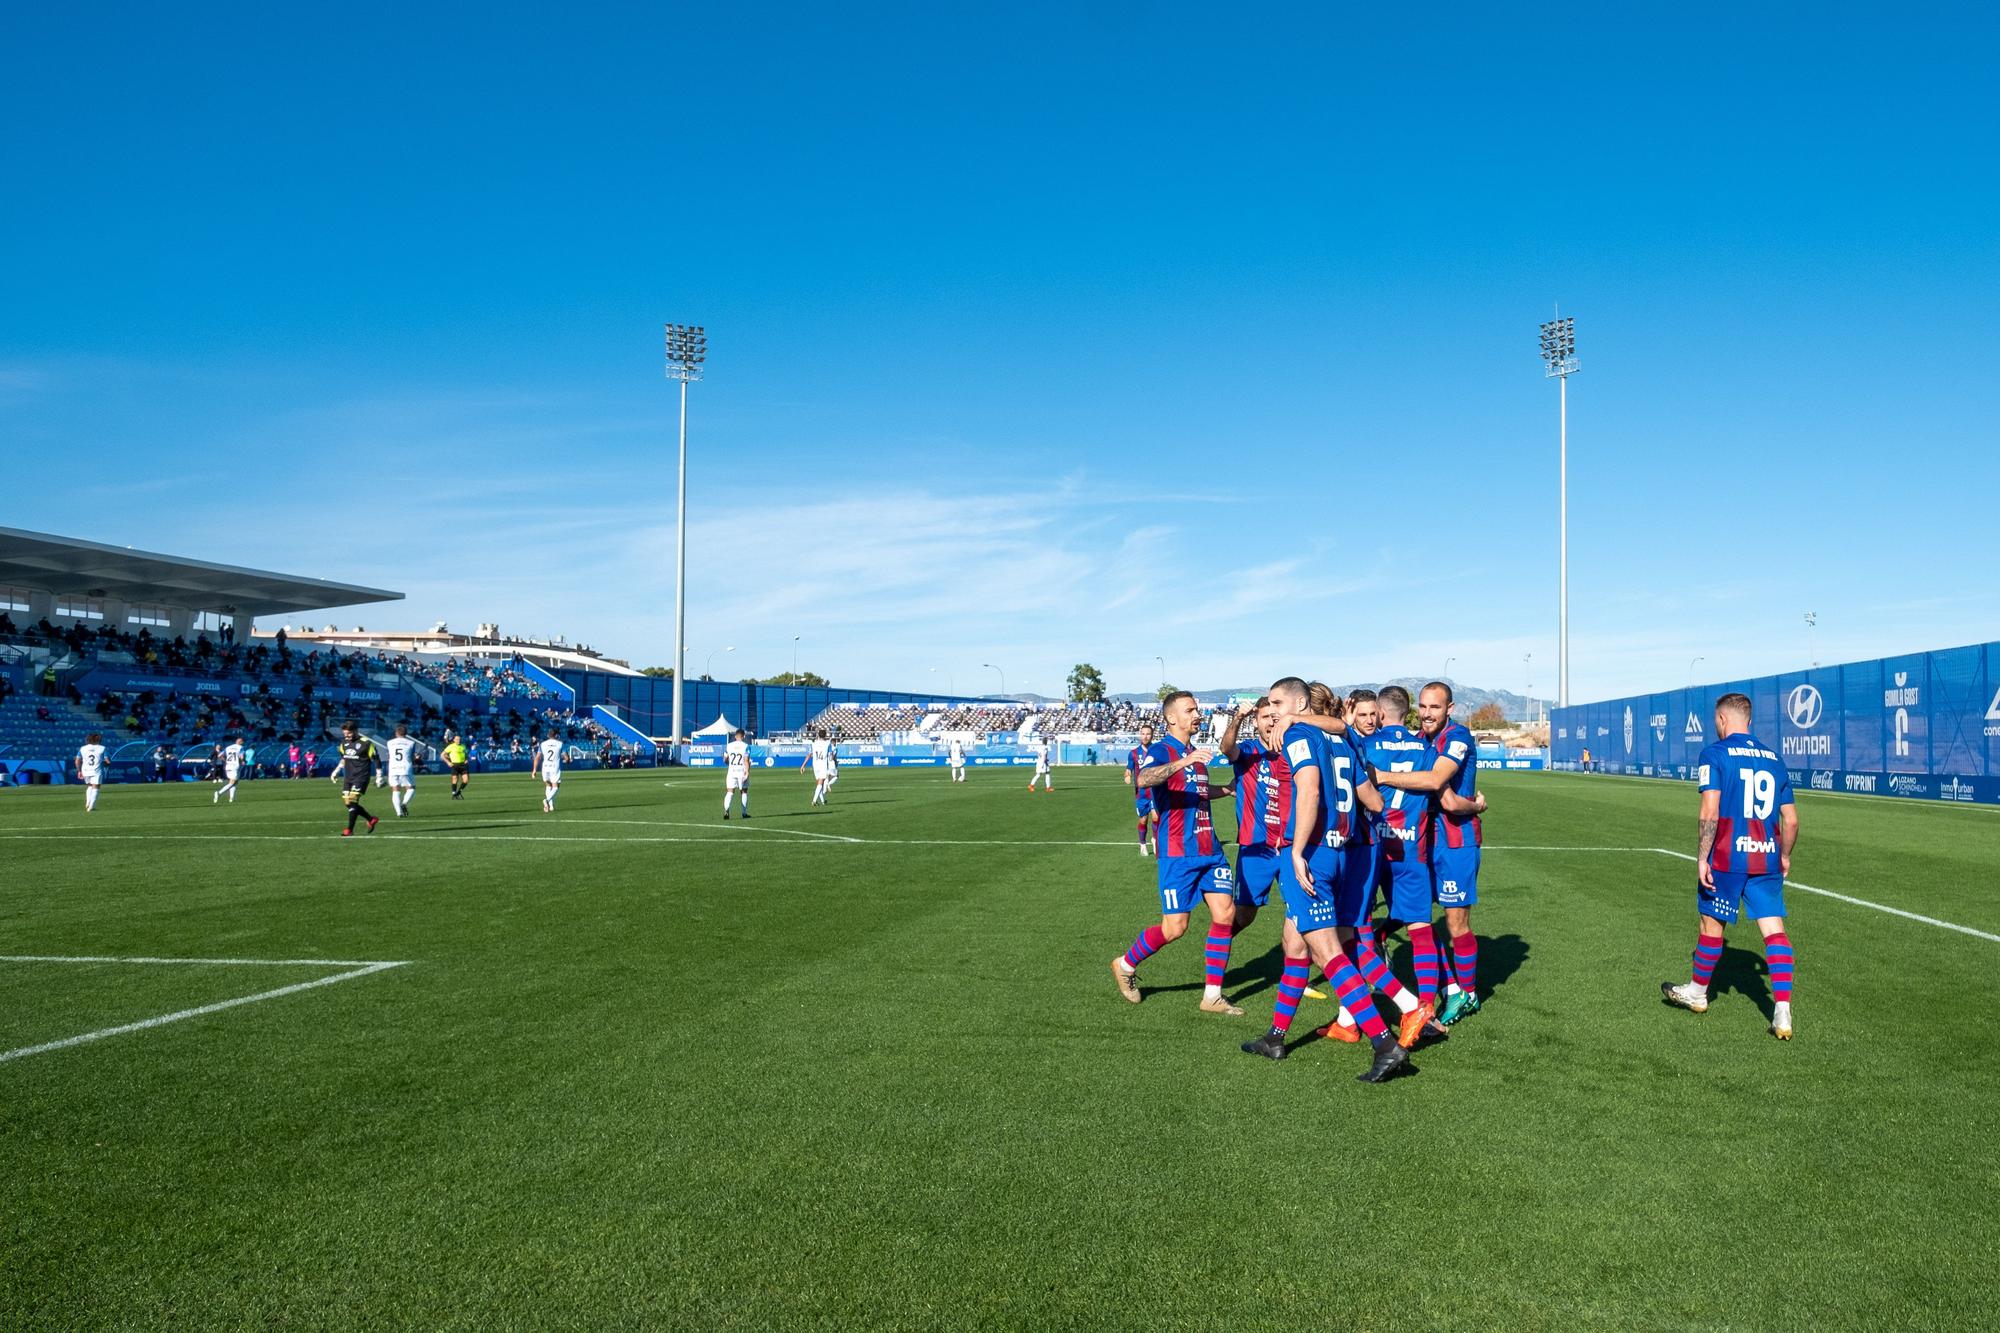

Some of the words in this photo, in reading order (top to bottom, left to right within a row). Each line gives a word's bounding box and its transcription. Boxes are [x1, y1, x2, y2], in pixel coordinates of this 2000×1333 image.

[1782, 735, 1831, 755] HYUNDAI
[88, 754, 96, 767] 3
[395, 748, 404, 762] 5
[546, 749, 555, 762] 2
[729, 752, 744, 766] 22
[1475, 760, 1502, 769] ankia
[1333, 756, 1354, 813] 5
[1390, 761, 1415, 809] 7
[1845, 775, 1877, 792] 971PRINT
[1739, 768, 1776, 820] 19
[1325, 829, 1345, 848] fib
[1375, 821, 1416, 842] fibwi
[1735, 835, 1776, 853] fibwi
[1163, 888, 1179, 910] 11
